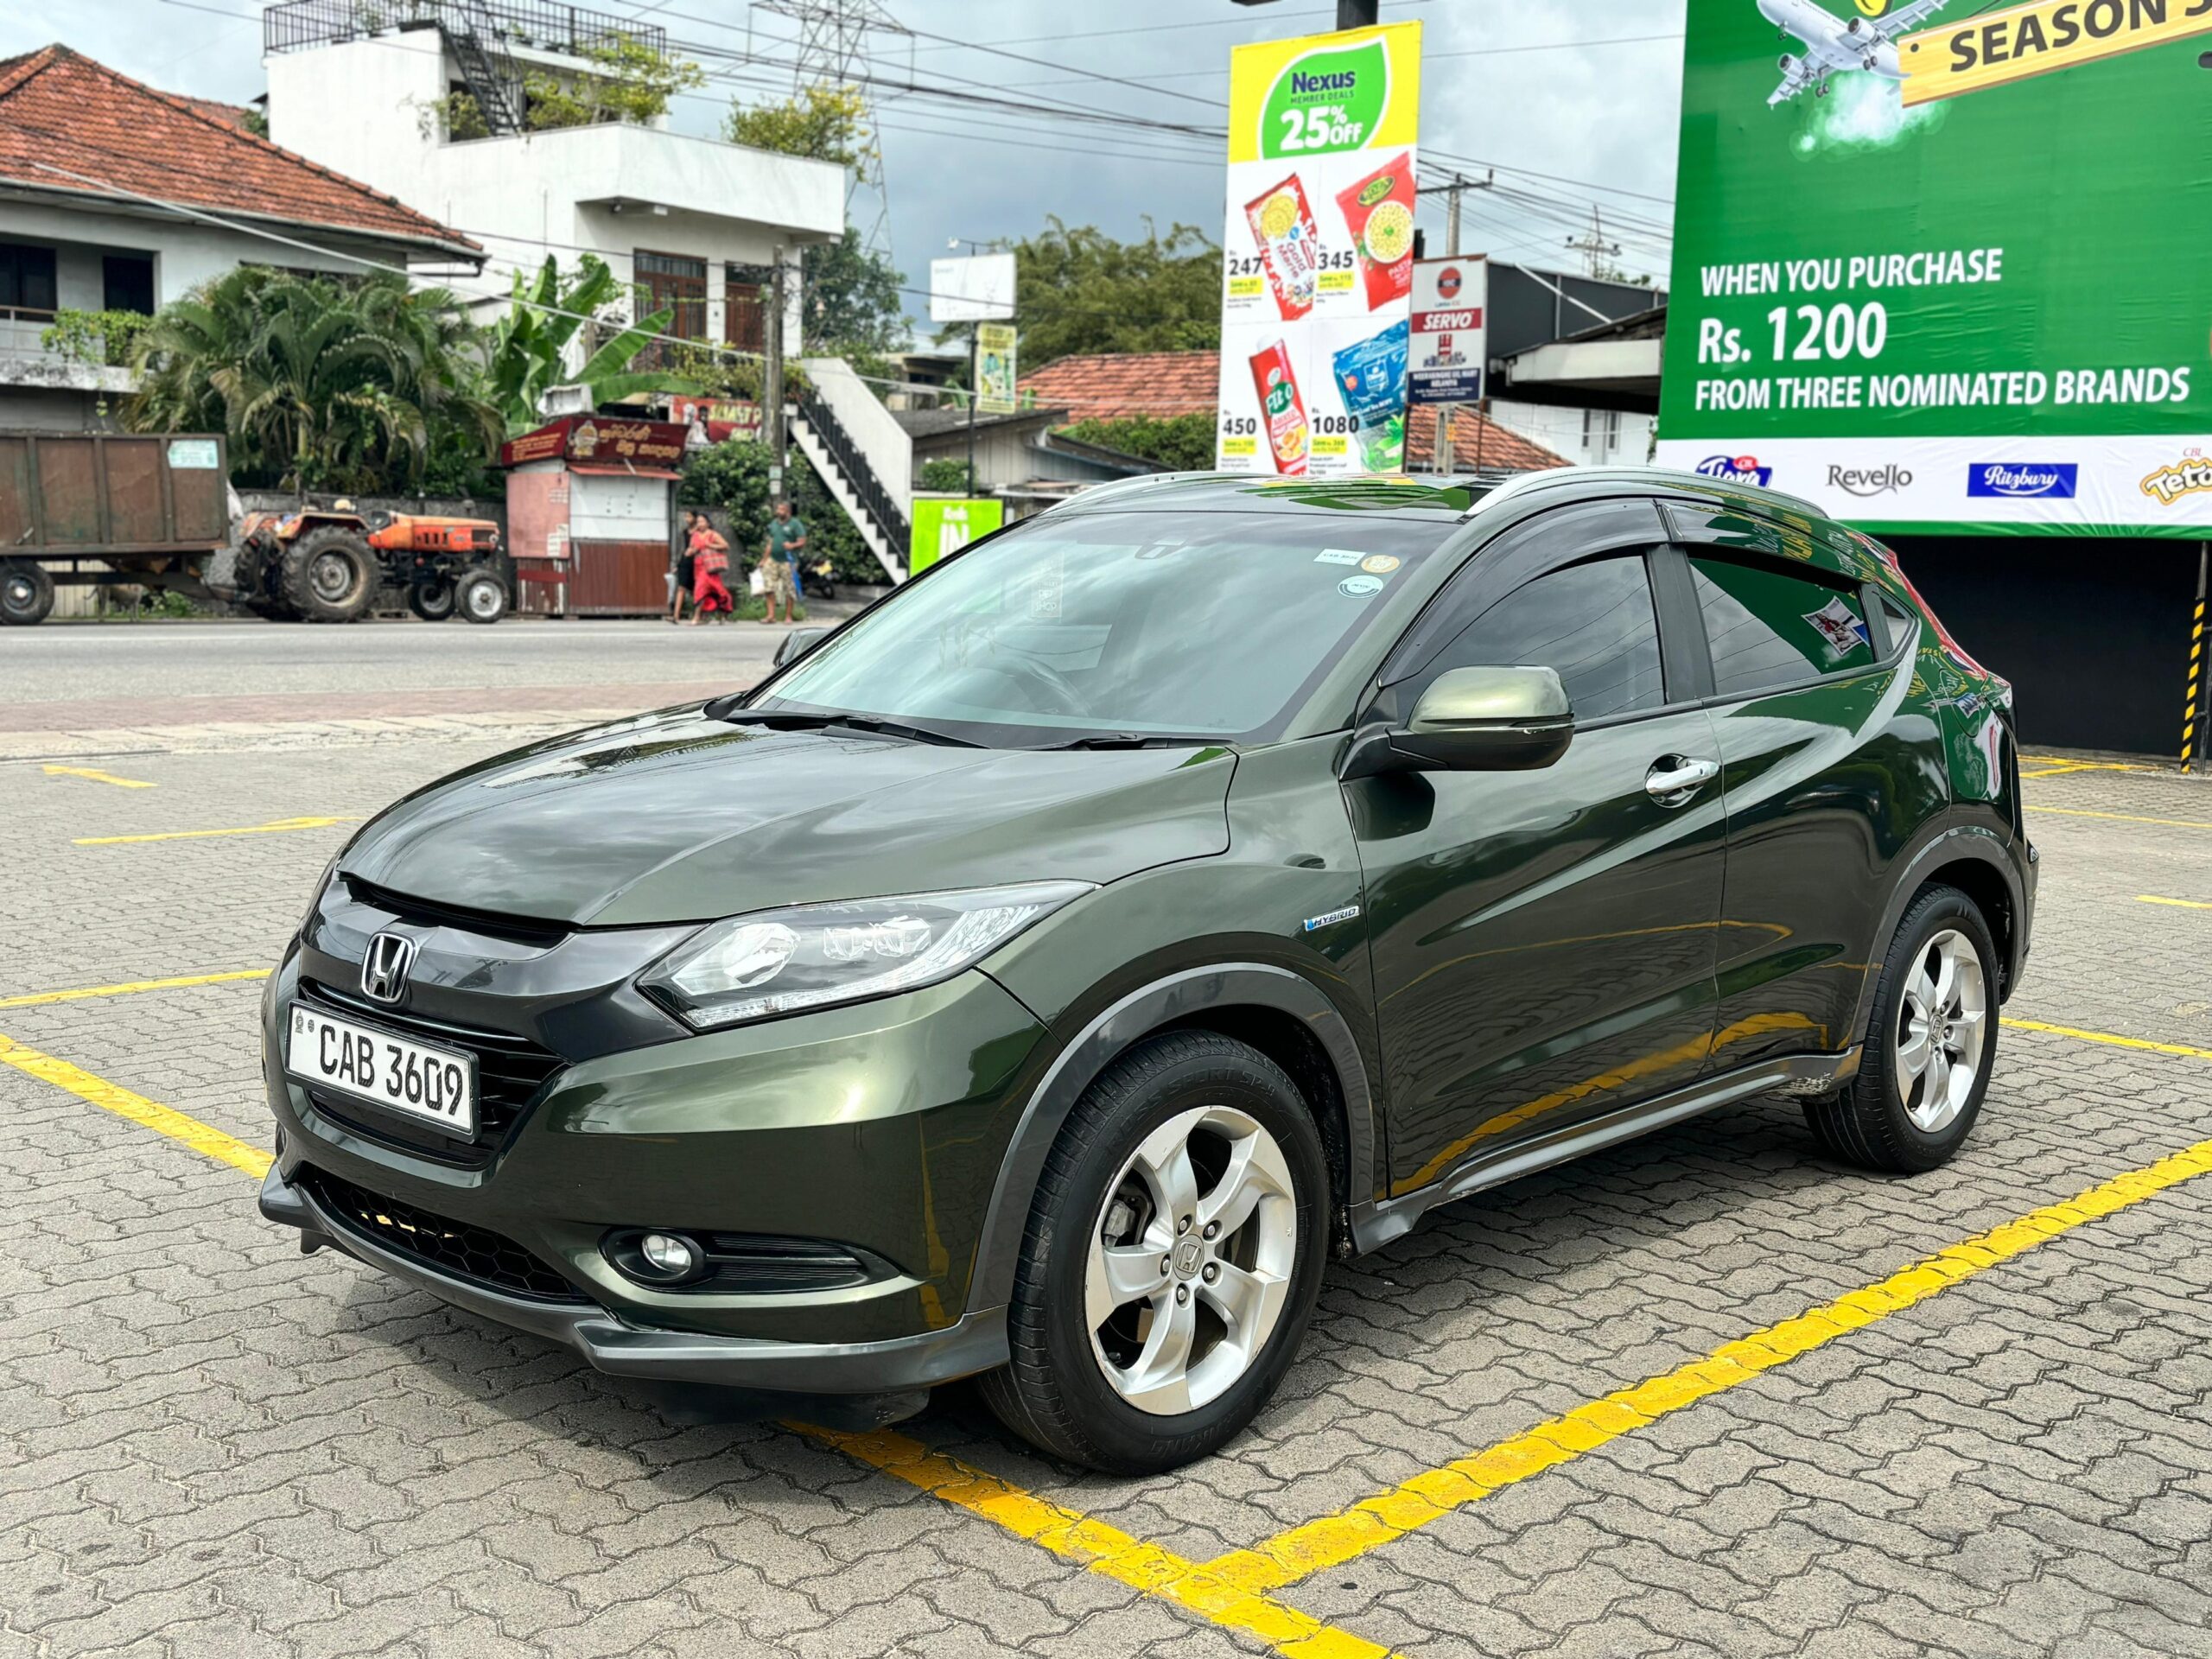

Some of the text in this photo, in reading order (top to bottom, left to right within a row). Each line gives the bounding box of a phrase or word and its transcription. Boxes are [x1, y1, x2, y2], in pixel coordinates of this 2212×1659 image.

[1949, 0, 2167, 72] SEASON
[1291, 71, 1356, 94] Nexus
[1290, 90, 1355, 104] MEMBER DEALS
[1229, 257, 1262, 276] 247
[1286, 242, 1306, 271] Gold
[1318, 251, 1353, 270] 345
[1700, 248, 2003, 296] WHEN YOU PURCHASE
[1423, 311, 1472, 330] SERVO
[1698, 302, 1888, 363] Rs. 1200
[1695, 367, 2190, 410] FROM THREE NOMINATED BRANDS
[1223, 417, 1256, 435] 450
[1313, 415, 1359, 434] 1080
[1825, 463, 1912, 494] Revello
[1984, 465, 2058, 491] Ritzbury
[1313, 907, 1356, 926] HYBRID
[320, 1024, 463, 1116] CAB 3609
